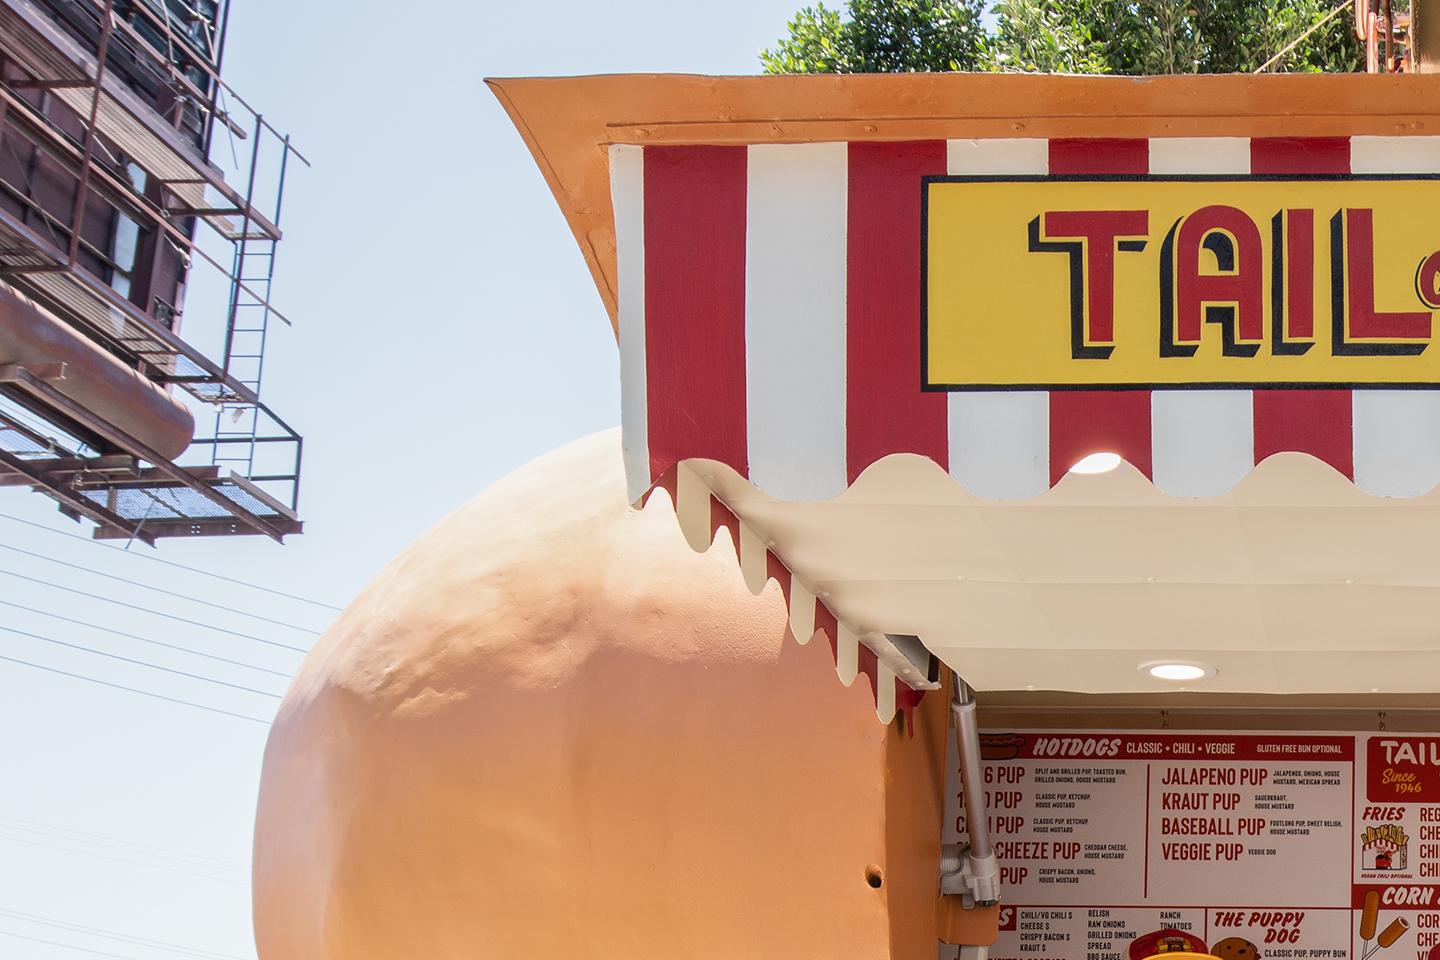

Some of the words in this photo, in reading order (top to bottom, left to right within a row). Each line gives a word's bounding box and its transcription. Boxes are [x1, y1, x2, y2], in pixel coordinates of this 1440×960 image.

[1028, 205, 1433, 360] TAIL
[1033, 738, 1121, 756] HOTDOGS
[1126, 742, 1162, 754] CLASSIC
[1173, 743, 1195, 754] CHILI
[1205, 743, 1235, 754] VEGGIE
[1257, 744, 1281, 753] GLUTEN
[1282, 745, 1297, 753] FREE
[1298, 745, 1311, 753] BUN
[1312, 745, 1342, 754] OPTIONAL
[997, 767, 1025, 783] PUP
[1162, 768, 1236, 785] JALAPENO
[1240, 768, 1268, 785] PUP
[1382, 768, 1416, 784] Since
[1395, 783, 1422, 793] 1946
[995, 792, 1023, 809] PUP
[1162, 793, 1209, 810] KRAUT
[1213, 793, 1240, 810] PUP
[1362, 807, 1405, 821] FRIES
[997, 817, 1024, 833] PUP
[1162, 818, 1233, 835] BASEBALL
[1238, 818, 1265, 835] PUP
[996, 842, 1049, 859] CHEEZE
[1053, 842, 1081, 859] PUP
[1162, 843, 1211, 860] VEGGIE
[1216, 844, 1243, 861] PUP
[1000, 867, 1028, 884] PUP
[1382, 887, 1434, 905] CORN
[1214, 912, 1245, 927] THE
[1248, 912, 1305, 927] PUPPY
[1264, 929, 1300, 943] DOG
[1087, 953, 1099, 960] BBQ
